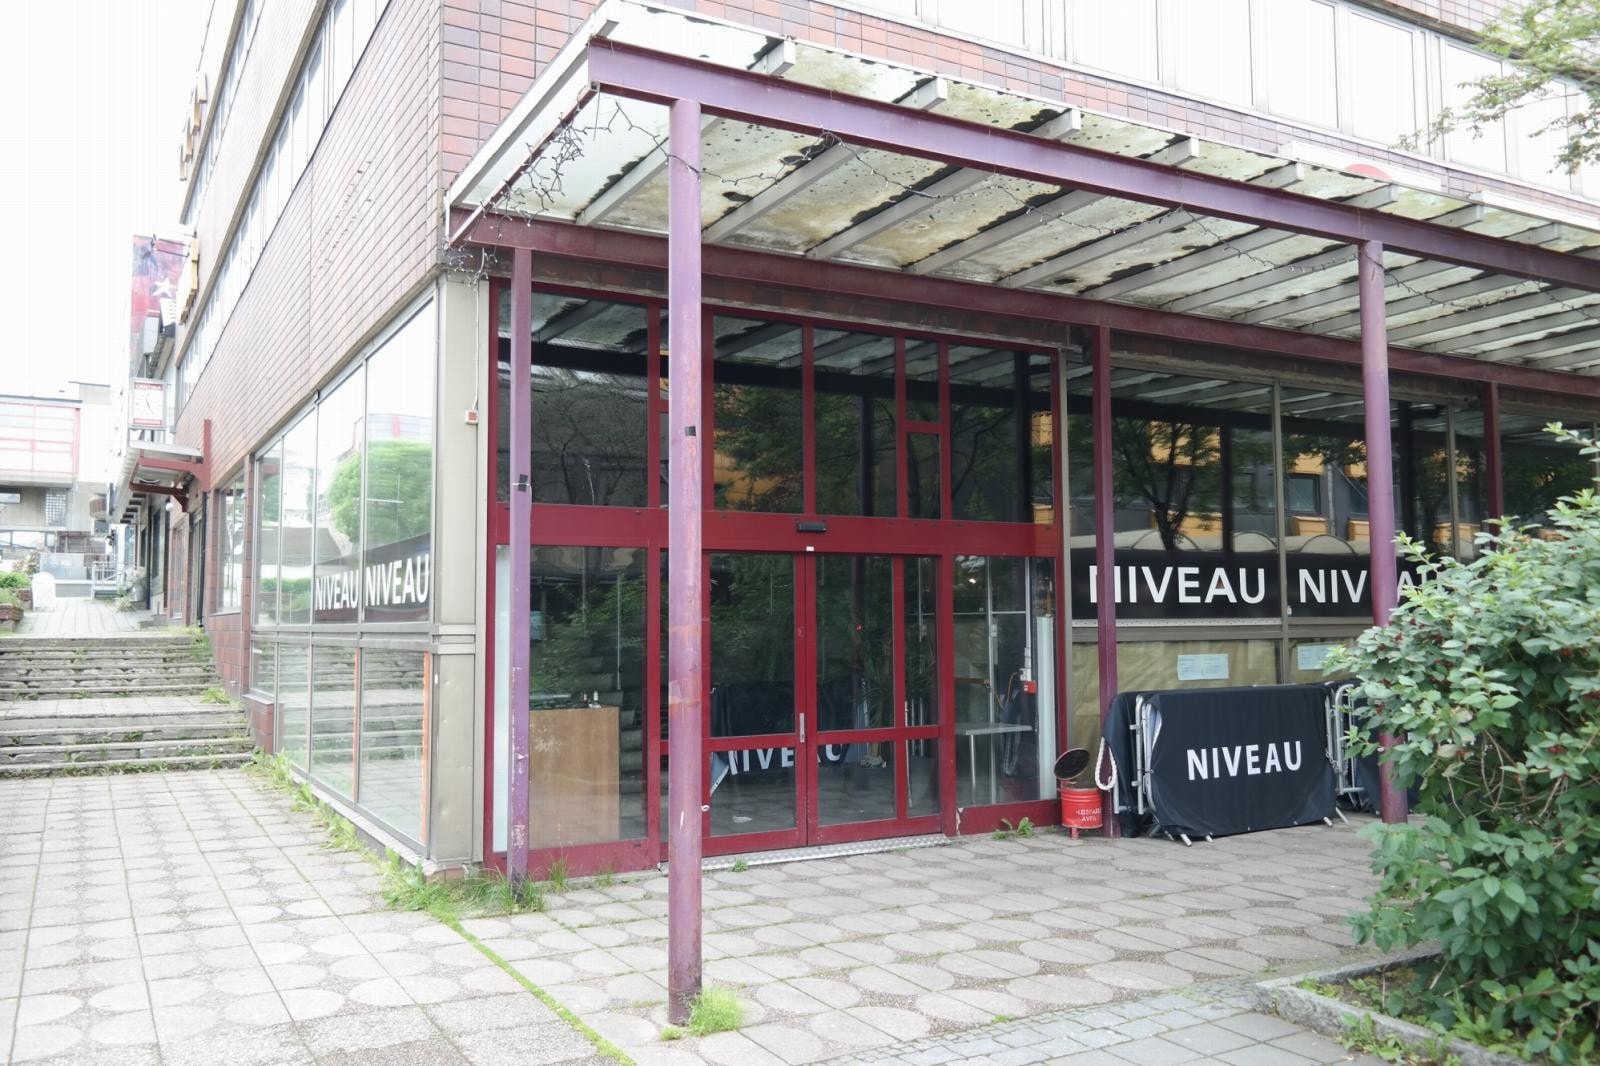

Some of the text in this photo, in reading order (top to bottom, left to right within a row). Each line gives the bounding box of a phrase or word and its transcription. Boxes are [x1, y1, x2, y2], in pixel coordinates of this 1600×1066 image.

[315, 569, 359, 610] NIVEAU
[366, 554, 430, 606] NIVEAU
[1089, 565, 1265, 604] NIVEAU
[1299, 569, 1430, 603] NIVA
[1187, 741, 1301, 780] NIVEAU
